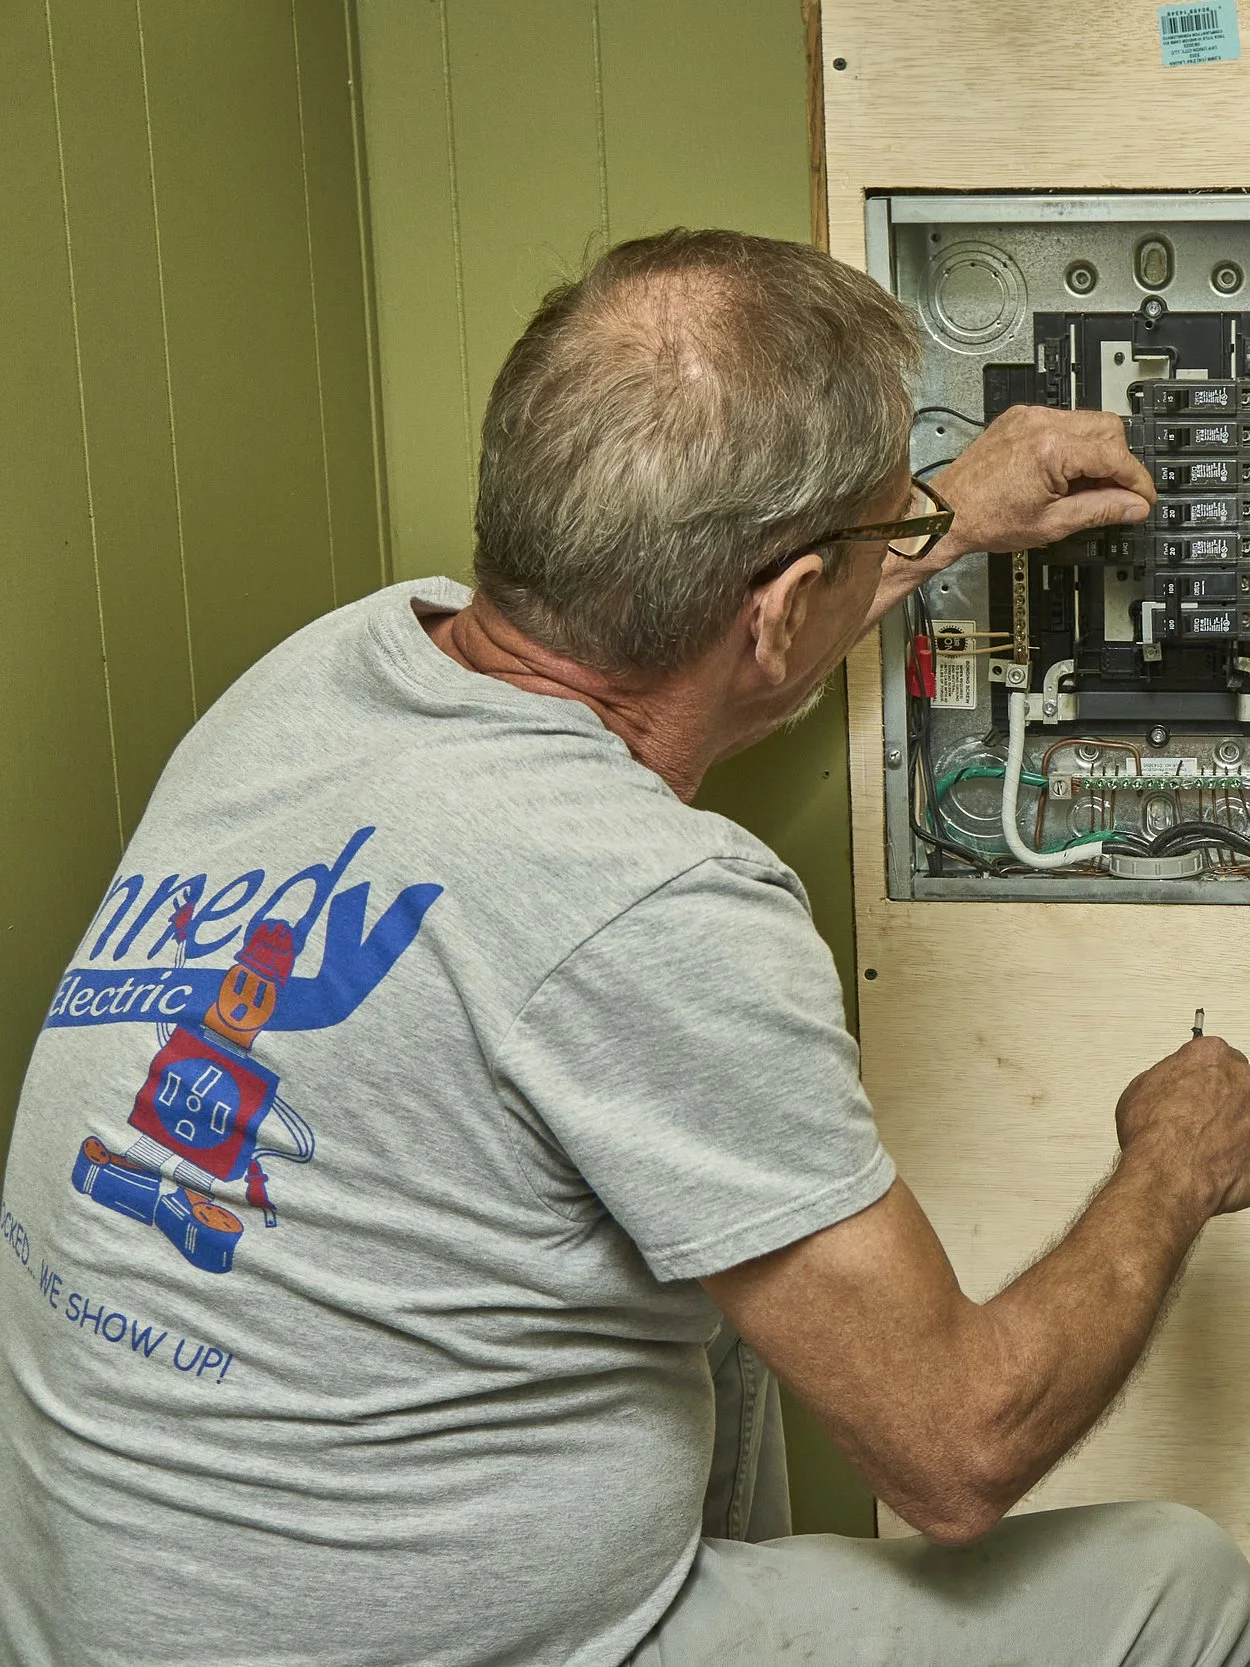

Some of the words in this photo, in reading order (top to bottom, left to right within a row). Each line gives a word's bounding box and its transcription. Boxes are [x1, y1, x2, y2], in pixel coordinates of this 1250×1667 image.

[49, 970, 193, 1016] Electric
[40, 1259, 63, 1309] WE
[65, 1293, 168, 1358] SHOW
[173, 1338, 233, 1385] UP!
